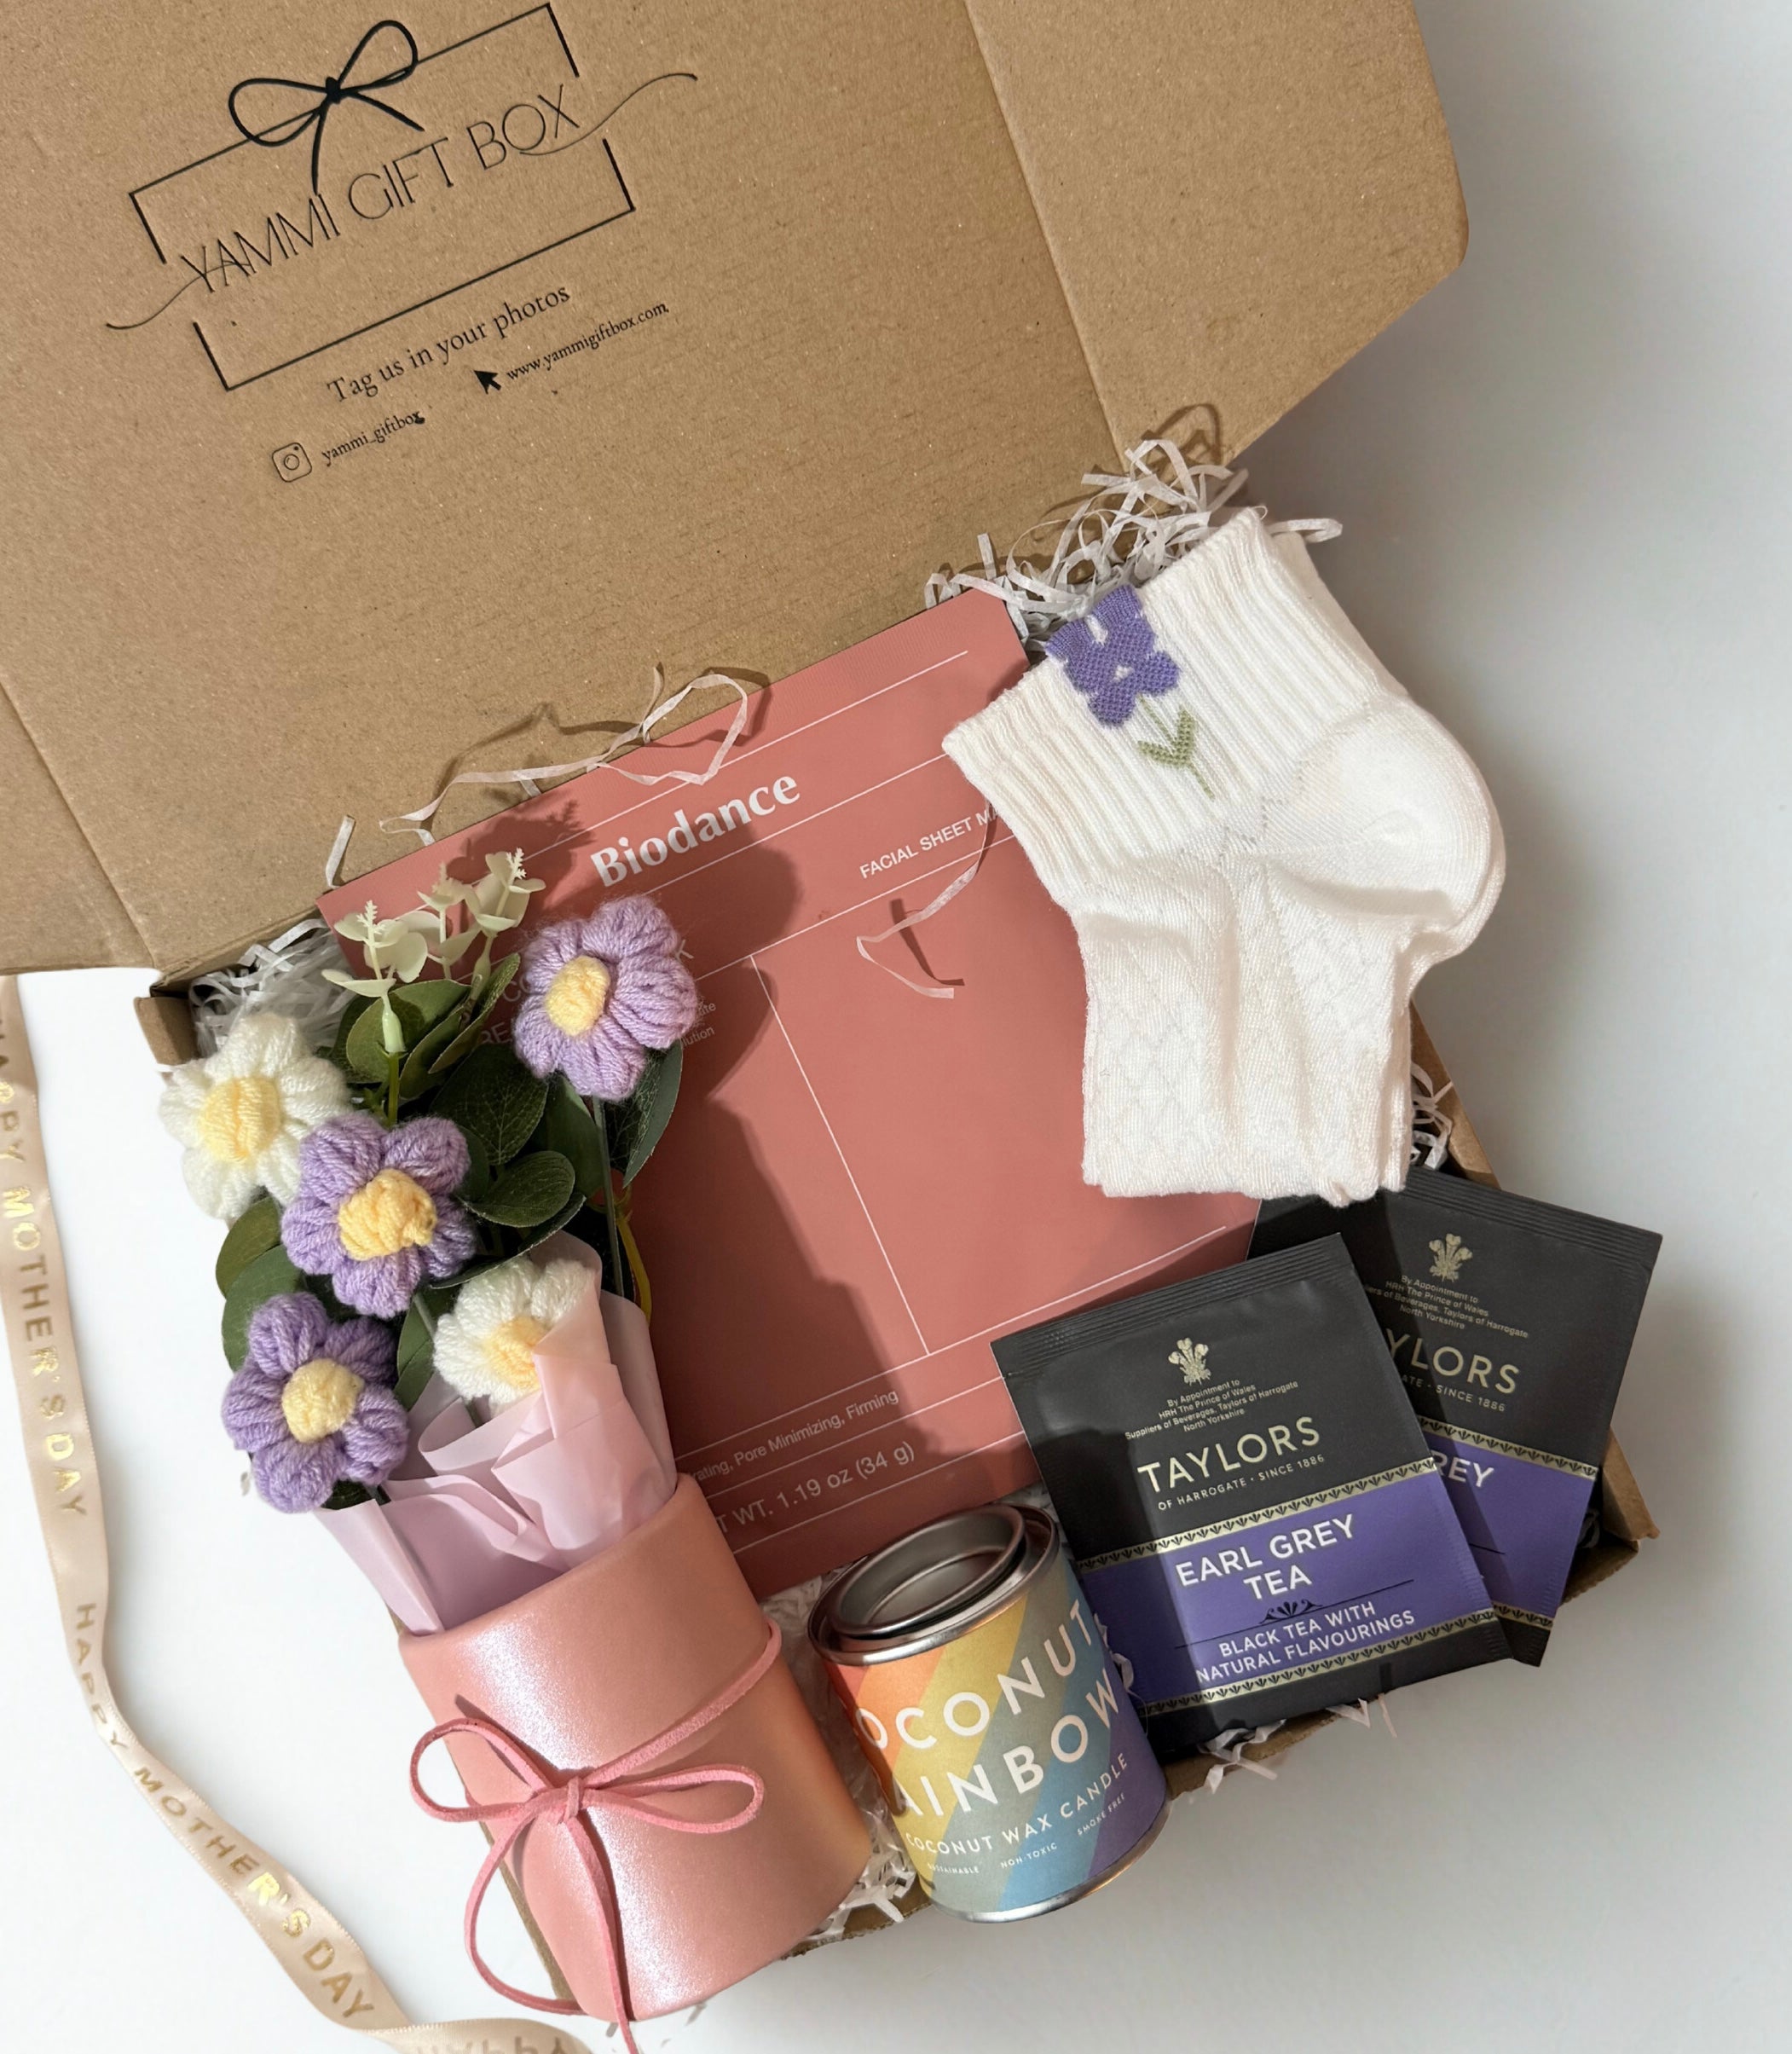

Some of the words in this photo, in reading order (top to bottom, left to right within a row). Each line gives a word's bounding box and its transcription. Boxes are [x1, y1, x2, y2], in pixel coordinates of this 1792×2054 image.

[180, 194, 341, 293] YAMMI
[348, 136, 454, 220] GIFT
[465, 84, 581, 171] BOX
[327, 373, 379, 402] Tag
[379, 359, 405, 382] us
[407, 348, 434, 369] in
[436, 322, 488, 365] your
[492, 286, 571, 338] photos
[321, 411, 425, 467] yammi_giftbox
[590, 776, 801, 888] Biodance
[859, 845, 919, 879] FACIAL
[919, 817, 972, 851] SHEET
[1399, 1305, 1423, 1317] North
[1425, 1311, 1465, 1330] Yorkshire
[1402, 1275, 1412, 1285] By
[1413, 1279, 1468, 1300] Appointment
[1469, 1294, 1479, 1304] to
[1407, 1286, 1422, 1298] The
[1424, 1291, 1452, 1305] Prince
[1453, 1300, 1463, 1309] of
[1464, 1302, 1489, 1317] Wales
[2, 1186, 67, 1420] MOTHER'S
[44, 1432, 88, 1517] DAY
[1443, 1306, 1474, 1322] Taylors
[1475, 1316, 1485, 1325] of
[1486, 1318, 1529, 1339] Harrogate
[1385, 1328, 1520, 1394] YLORS
[1124, 1425, 1162, 1440] Suppliers
[1163, 1420, 1172, 1429] of
[1217, 1397, 1247, 1411] Taylors
[1247, 1393, 1257, 1403] of
[1257, 1380, 1299, 1398] Harrogate
[1159, 1409, 1178, 1420] HRH
[1178, 1403, 1194, 1415] The
[1194, 1395, 1221, 1409] Prince
[1222, 1392, 1231, 1401] of
[1231, 1384, 1257, 1397] Wales
[1166, 1398, 1178, 1408] By
[1179, 1381, 1231, 1405] Appointment
[1231, 1379, 1240, 1387] to
[1183, 1420, 1206, 1433] North
[1206, 1409, 1246, 1426] Yorkshire
[1436, 1385, 1473, 1403] SINCE
[1477, 1397, 1506, 1412] 1886
[733, 1445, 767, 1467] Pore
[767, 1412, 846, 1453] Minimizing,
[846, 1390, 899, 1421] Firming
[1136, 1415, 1321, 1493] TAYLORS
[731, 1498, 773, 1526] WT.
[776, 1478, 822, 1509] 1.19
[827, 1468, 853, 1490] oz
[855, 1450, 887, 1480] (34
[893, 1440, 915, 1466] g)
[1157, 1500, 1173, 1512] OF
[1176, 1477, 1247, 1507] HARROGATE
[1257, 1463, 1294, 1482] SINCE
[1297, 1454, 1325, 1470] 1886
[1431, 1449, 1494, 1487] REY
[1175, 1546, 1263, 1588] EARL
[1269, 1513, 1354, 1559] GREY
[1243, 1565, 1313, 1600] TEA
[1194, 1649, 1280, 1684] NATURAL
[1283, 1610, 1415, 1661] FLAVOURINGS
[1218, 1629, 1280, 1658] BLACK
[1283, 1618, 1322, 1640] TEA
[1324, 1600, 1376, 1628] WITH
[855, 1599, 1093, 1750] OCONUT
[891, 1667, 1120, 1817] AINBOW
[76, 1602, 129, 1750] HAPPY
[134, 1766, 311, 1938] MOTHER'S
[303, 1937, 375, 2019] DAY
[905, 1831, 993, 1855] COCONUT
[1002, 1814, 1053, 1844] WAX
[1060, 1752, 1128, 1818] CANDLE
[1077, 1809, 1107, 1836] SMOKE
